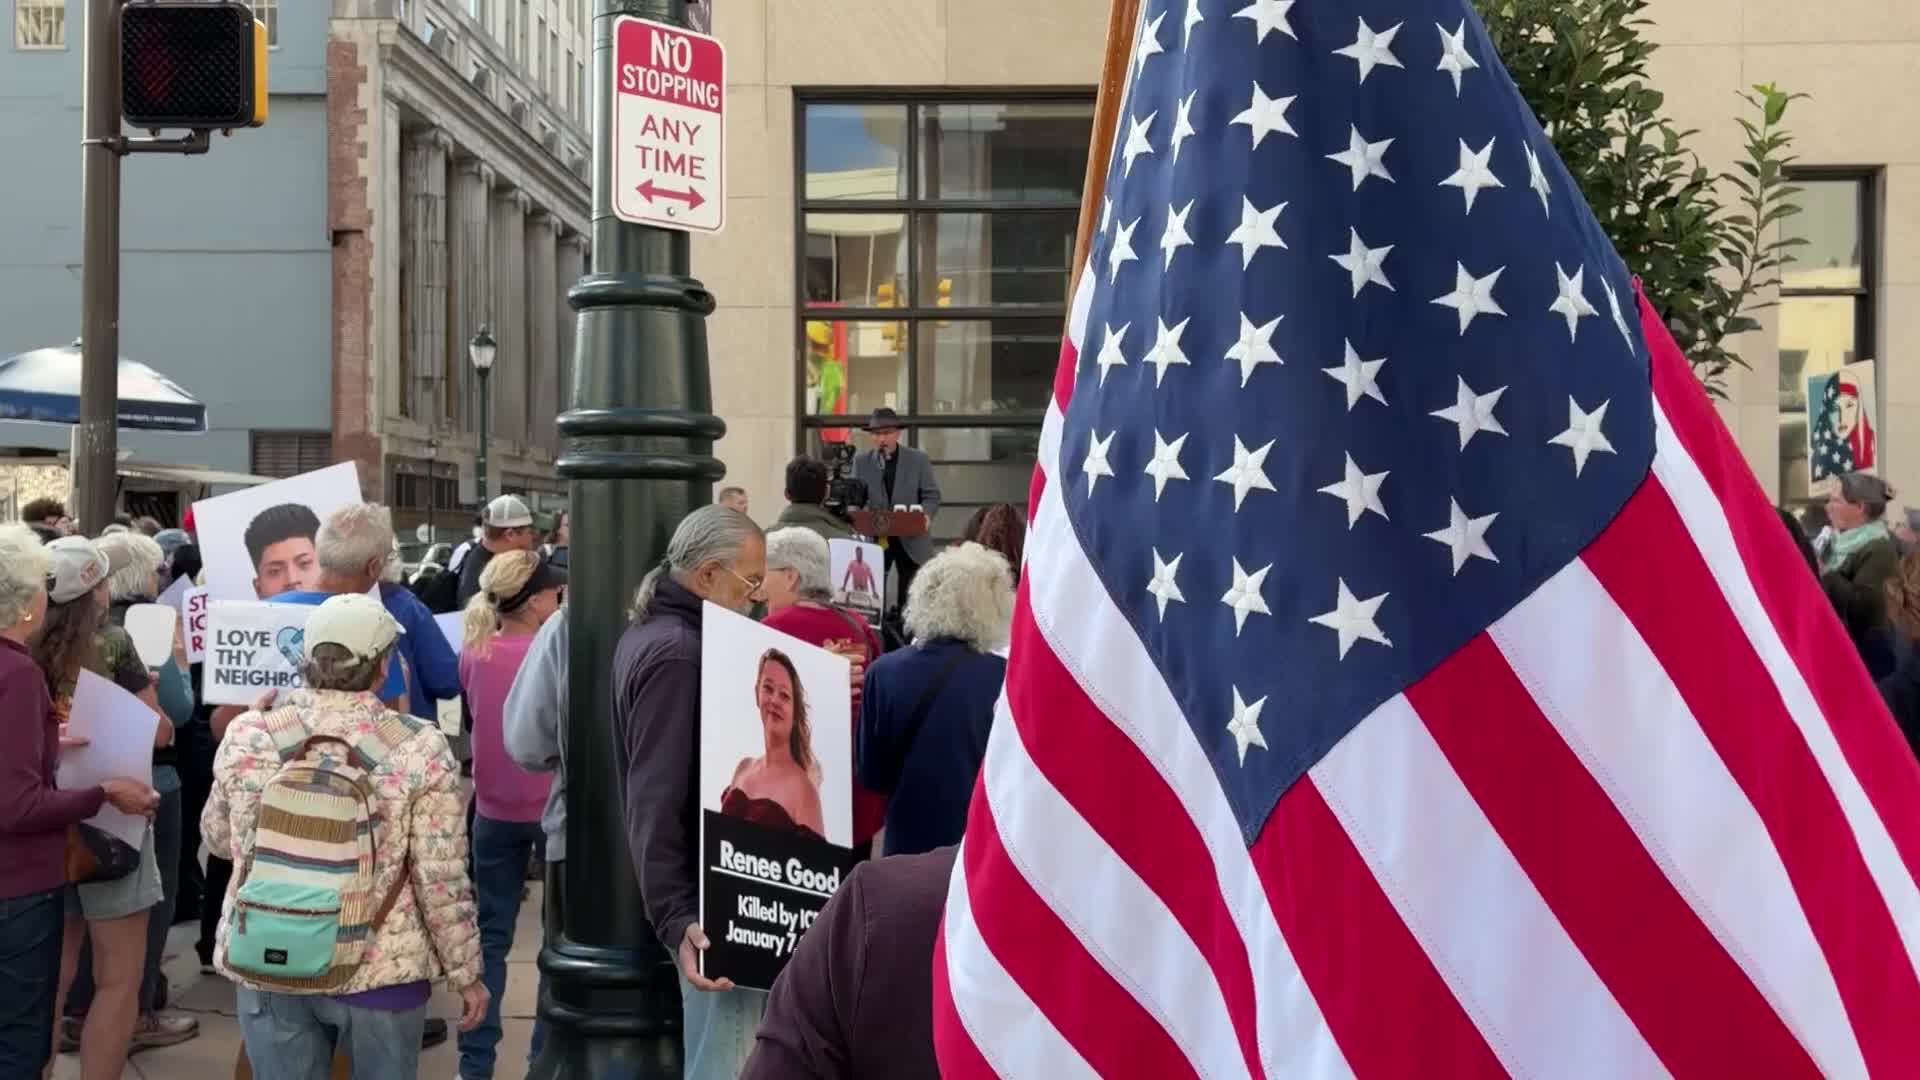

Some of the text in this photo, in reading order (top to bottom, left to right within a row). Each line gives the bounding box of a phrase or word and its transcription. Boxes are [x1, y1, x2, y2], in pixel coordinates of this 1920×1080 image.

[651, 29, 692, 73] NO
[622, 63, 720, 108] STOPPING
[640, 113, 701, 146] ANY
[635, 144, 706, 180] TIME
[216, 629, 271, 647] LOVE
[215, 649, 257, 666] THY
[720, 839, 840, 893] Renee Good
[737, 894, 778, 924] Killed
[779, 902, 799, 932] by
[725, 920, 785, 957] January
